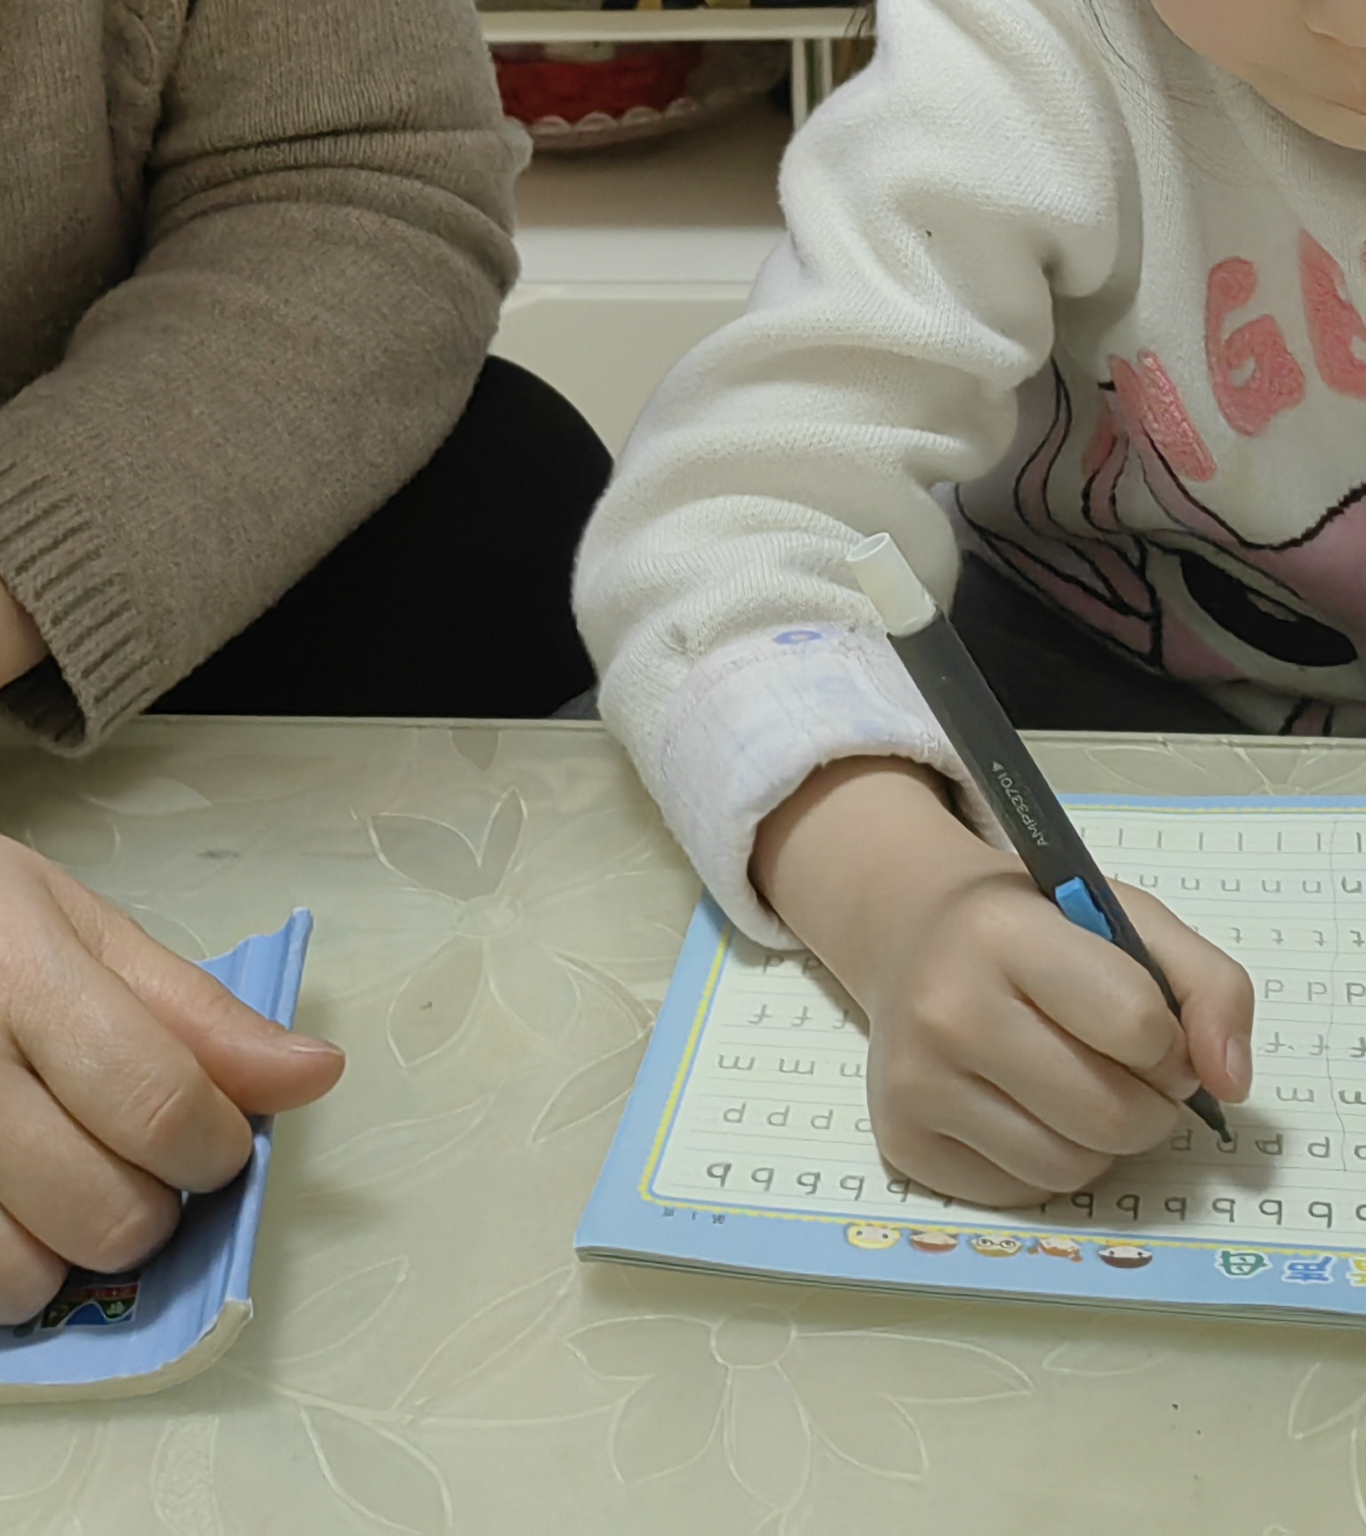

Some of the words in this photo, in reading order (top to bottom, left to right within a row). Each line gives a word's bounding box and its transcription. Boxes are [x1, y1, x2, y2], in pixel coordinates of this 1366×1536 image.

[1265, 980, 1284, 998] d
[1346, 982, 1366, 1004] d
[718, 1055, 755, 1070] m
[779, 1058, 815, 1075] m
[1276, 1087, 1314, 1102] m
[723, 1102, 746, 1123] p
[767, 1106, 790, 1126] p
[810, 1110, 833, 1130] p
[1307, 1136, 1330, 1158] p
[707, 1162, 732, 1188] b
[751, 1168, 775, 1192] b
[796, 1172, 821, 1195] b
[839, 1175, 865, 1202] b
[1116, 1194, 1139, 1221] b
[1165, 1197, 1187, 1222] b
[1212, 1198, 1235, 1222] b
[1259, 1199, 1283, 1226] b
[1308, 1201, 1333, 1229] b
